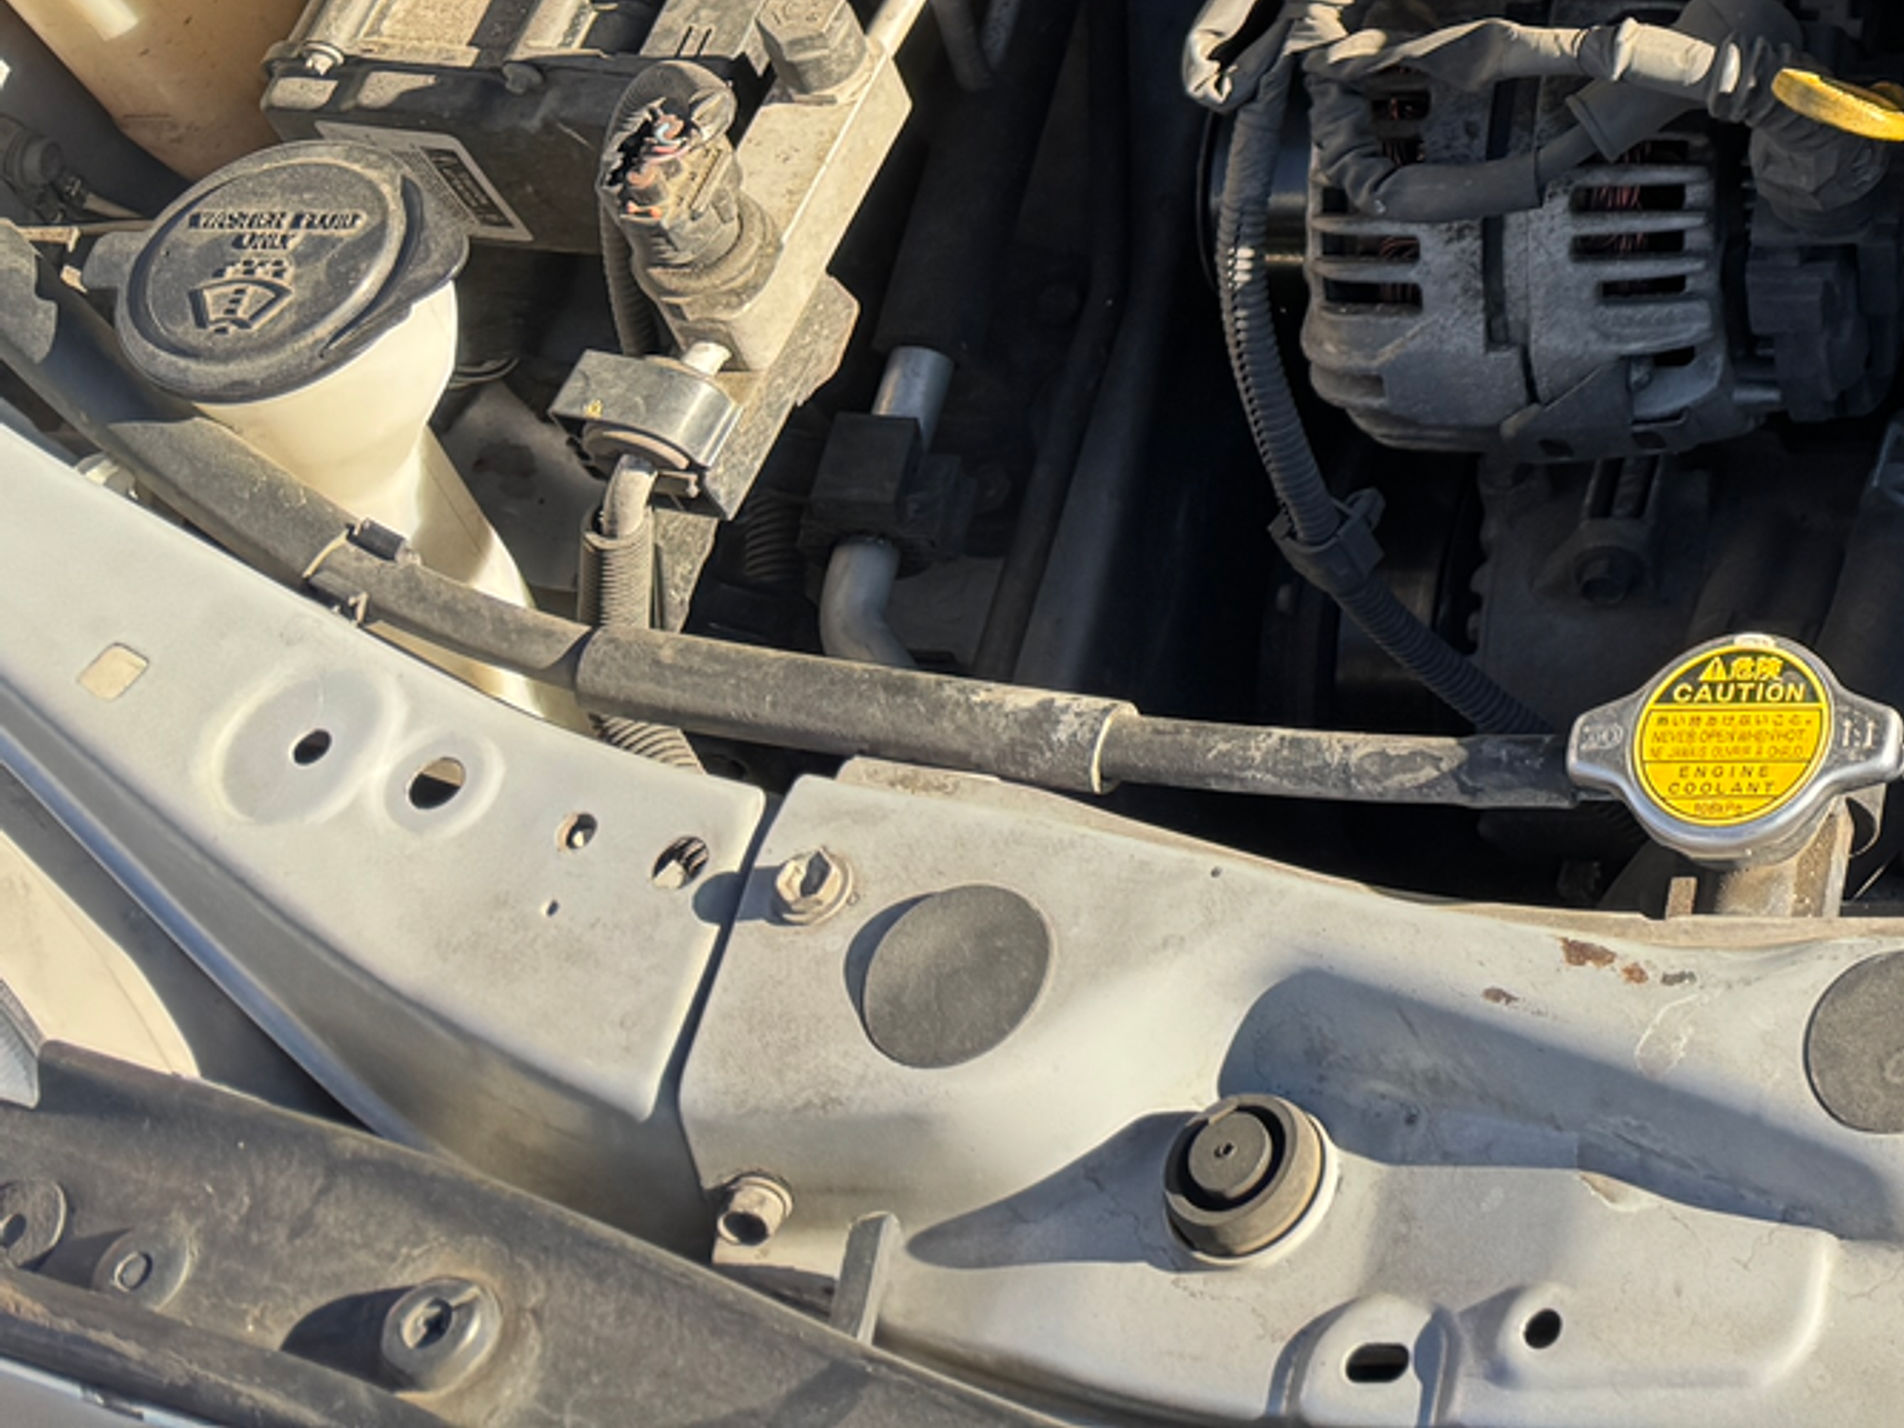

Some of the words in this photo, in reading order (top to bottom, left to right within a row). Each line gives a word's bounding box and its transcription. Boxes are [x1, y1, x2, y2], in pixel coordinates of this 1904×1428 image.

[1672, 682, 1806, 704] CAUTION
[1678, 765, 1770, 779] ENGINE
[1667, 782, 1776, 796] COOLANT
